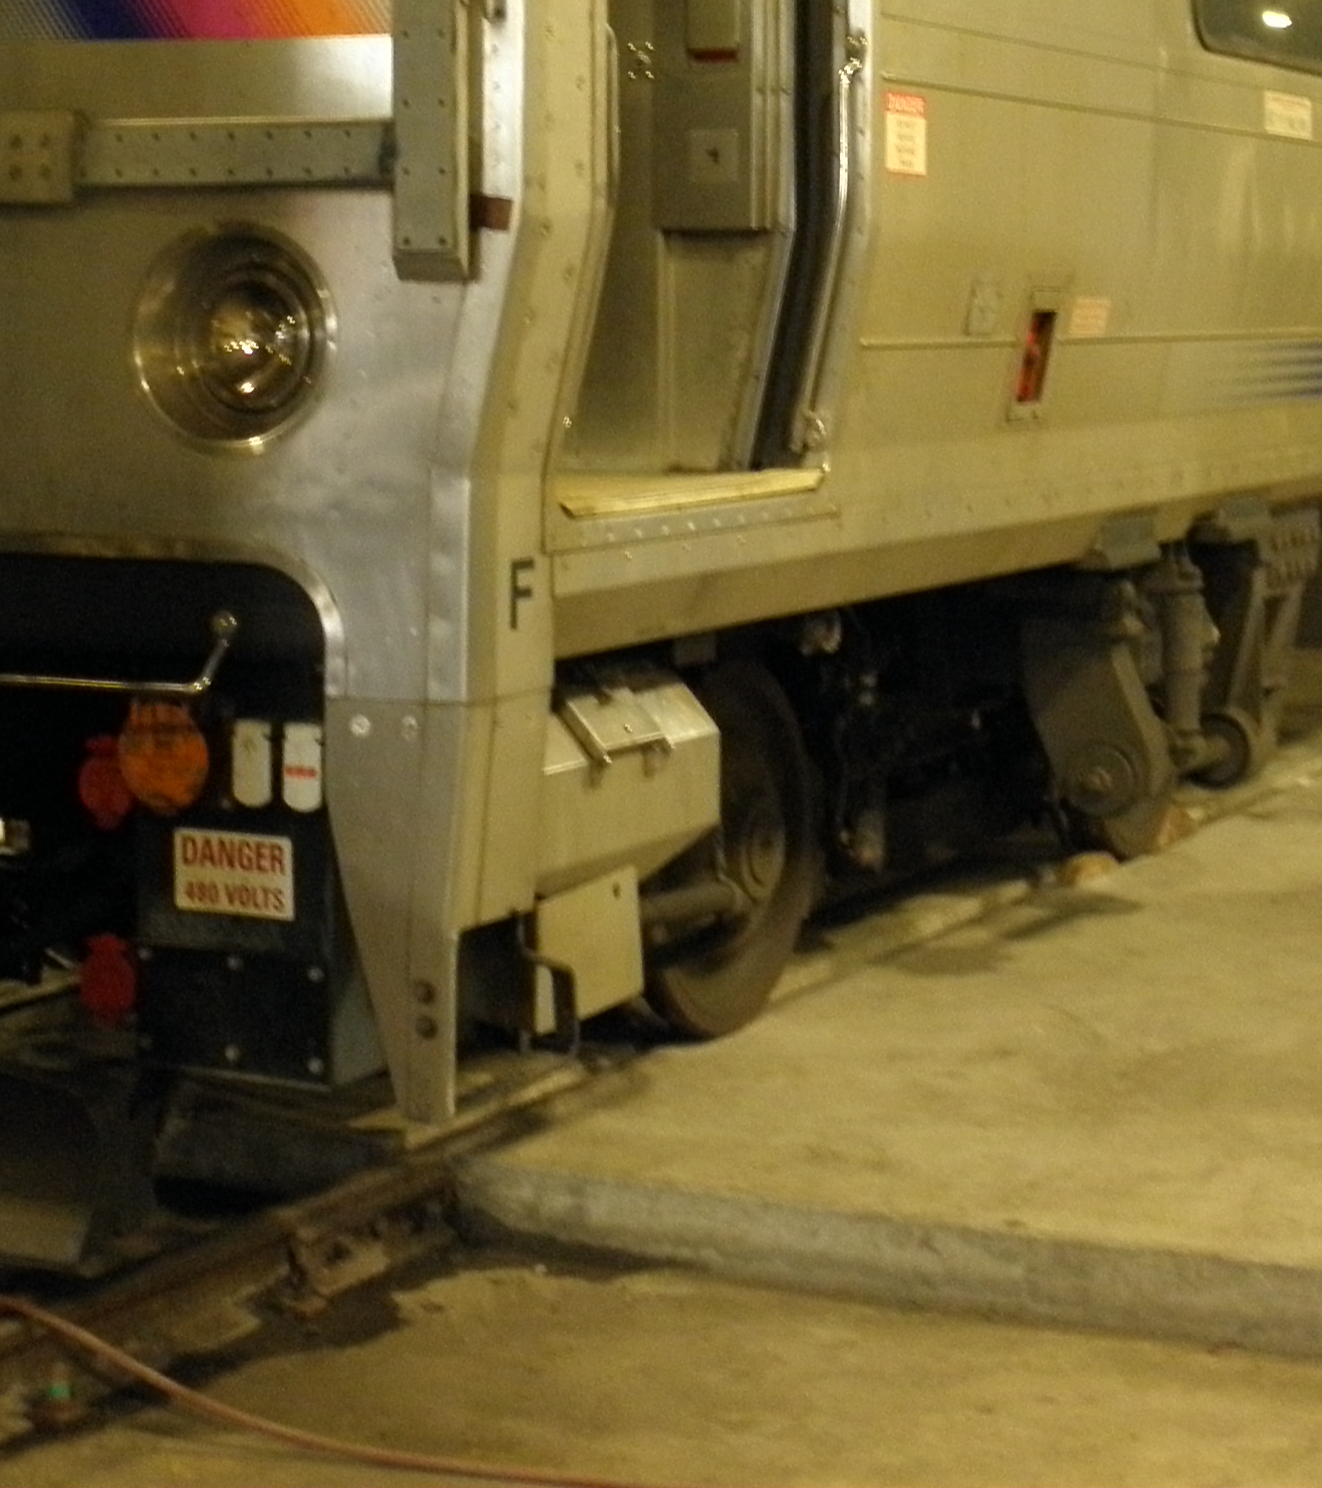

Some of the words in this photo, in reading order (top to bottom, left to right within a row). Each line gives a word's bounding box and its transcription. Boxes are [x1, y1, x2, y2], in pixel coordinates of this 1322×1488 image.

[510, 558, 534, 630] F
[182, 836, 285, 874] DANGER
[225, 882, 285, 910] VOLTS
